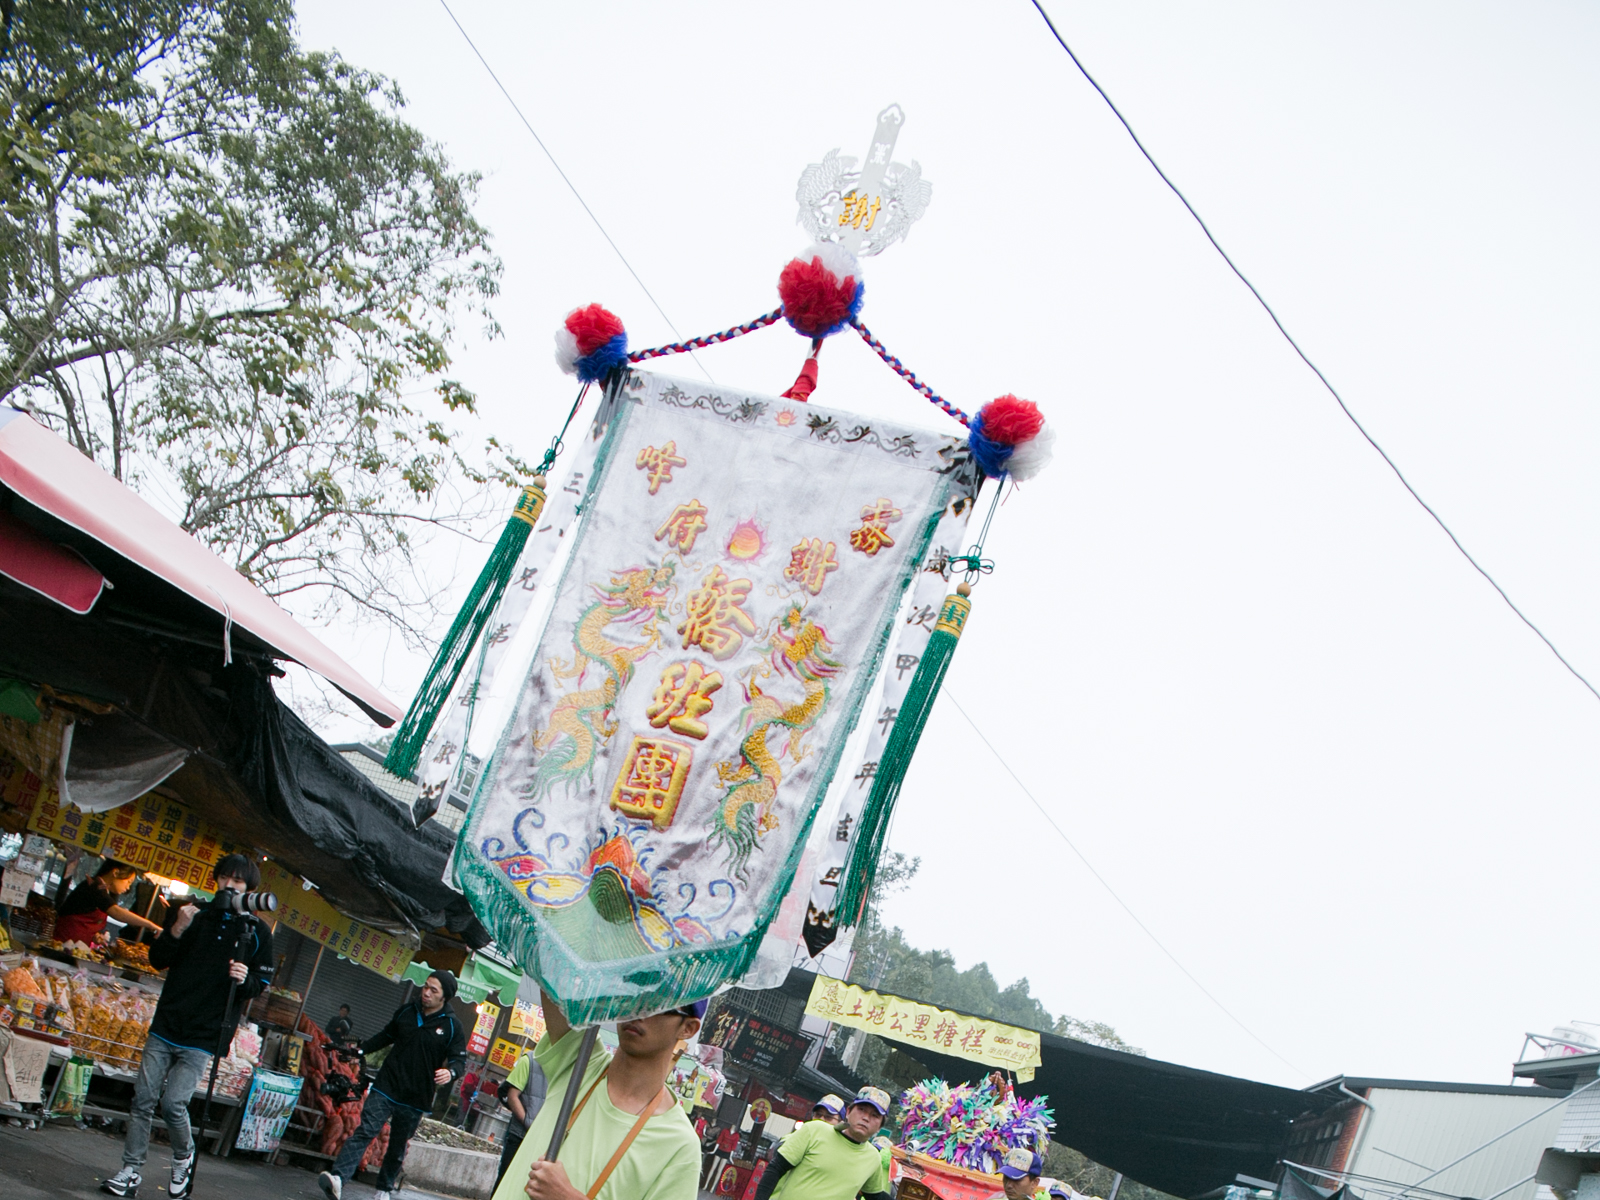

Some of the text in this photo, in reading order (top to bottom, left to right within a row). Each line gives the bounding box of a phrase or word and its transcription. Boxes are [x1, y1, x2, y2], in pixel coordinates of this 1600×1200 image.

[838, 191, 882, 232] 謝
[846, 998, 986, 1055] 土地公黑糖糕
